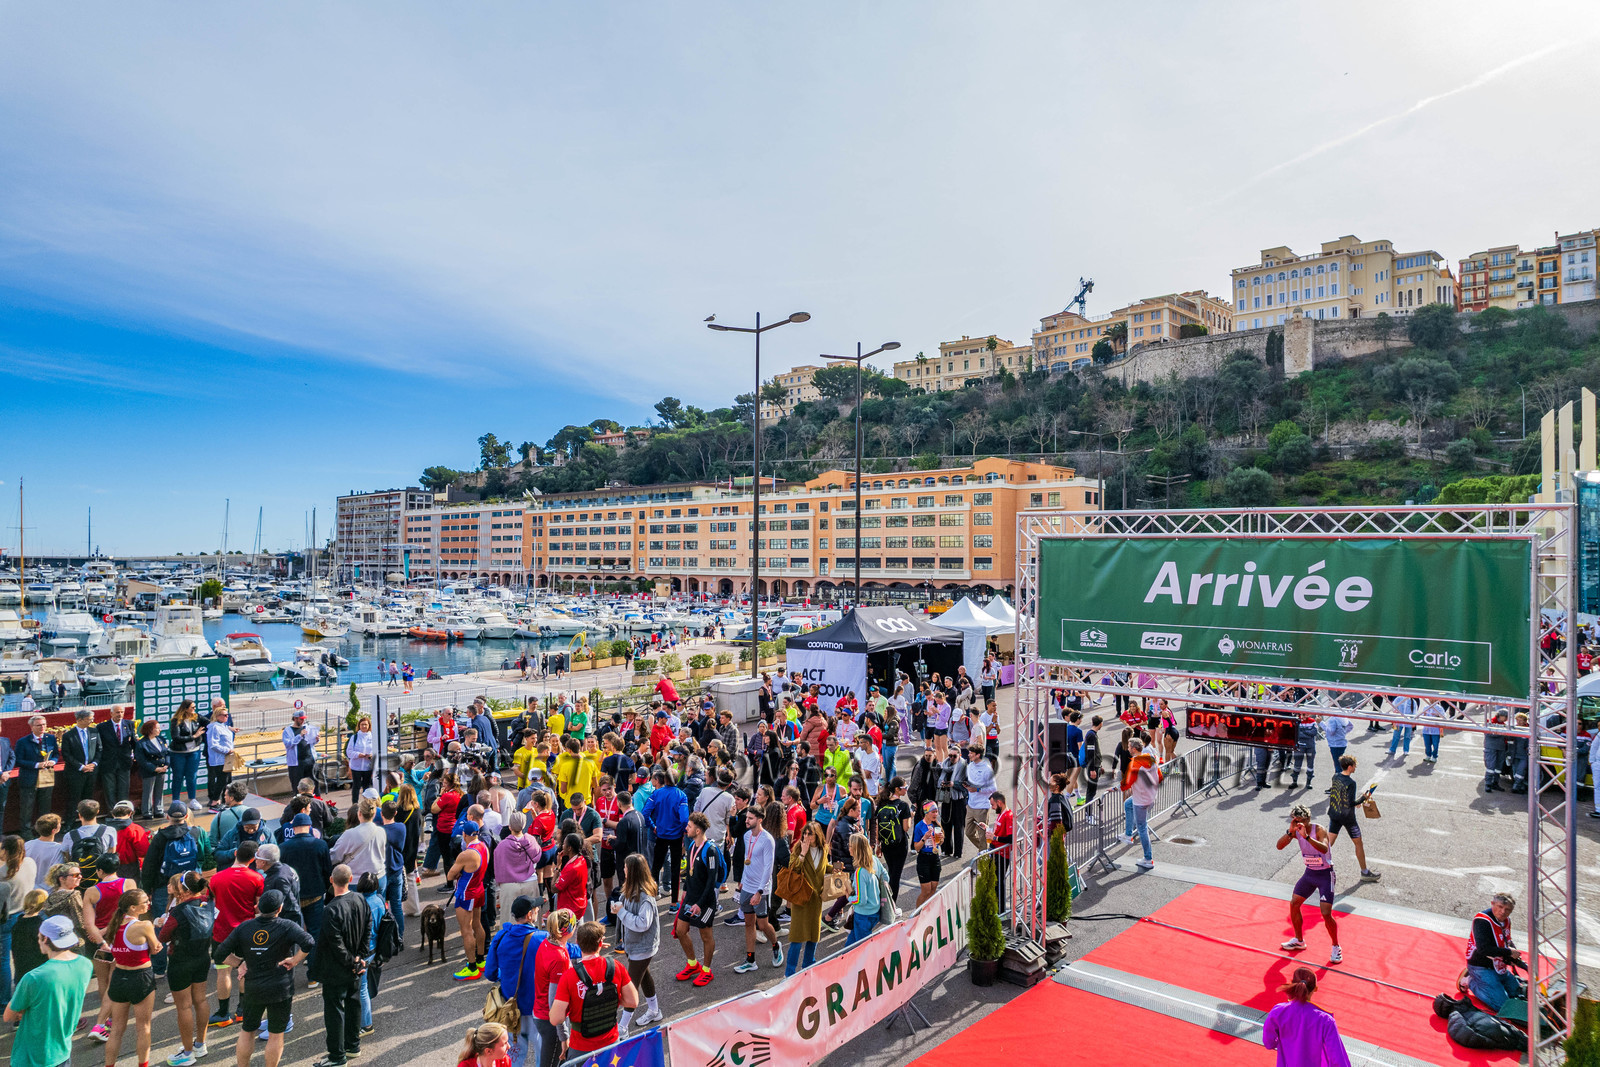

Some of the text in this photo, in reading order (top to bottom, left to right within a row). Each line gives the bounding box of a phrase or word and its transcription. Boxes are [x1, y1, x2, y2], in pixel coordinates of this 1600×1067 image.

[1143, 559, 1373, 612] Arrivée
[1144, 636, 1178, 647] 42K
[1237, 640, 1293, 652] MONAFRAIS
[1408, 649, 1461, 667] Carlo
[802, 668, 826, 682] ACT
